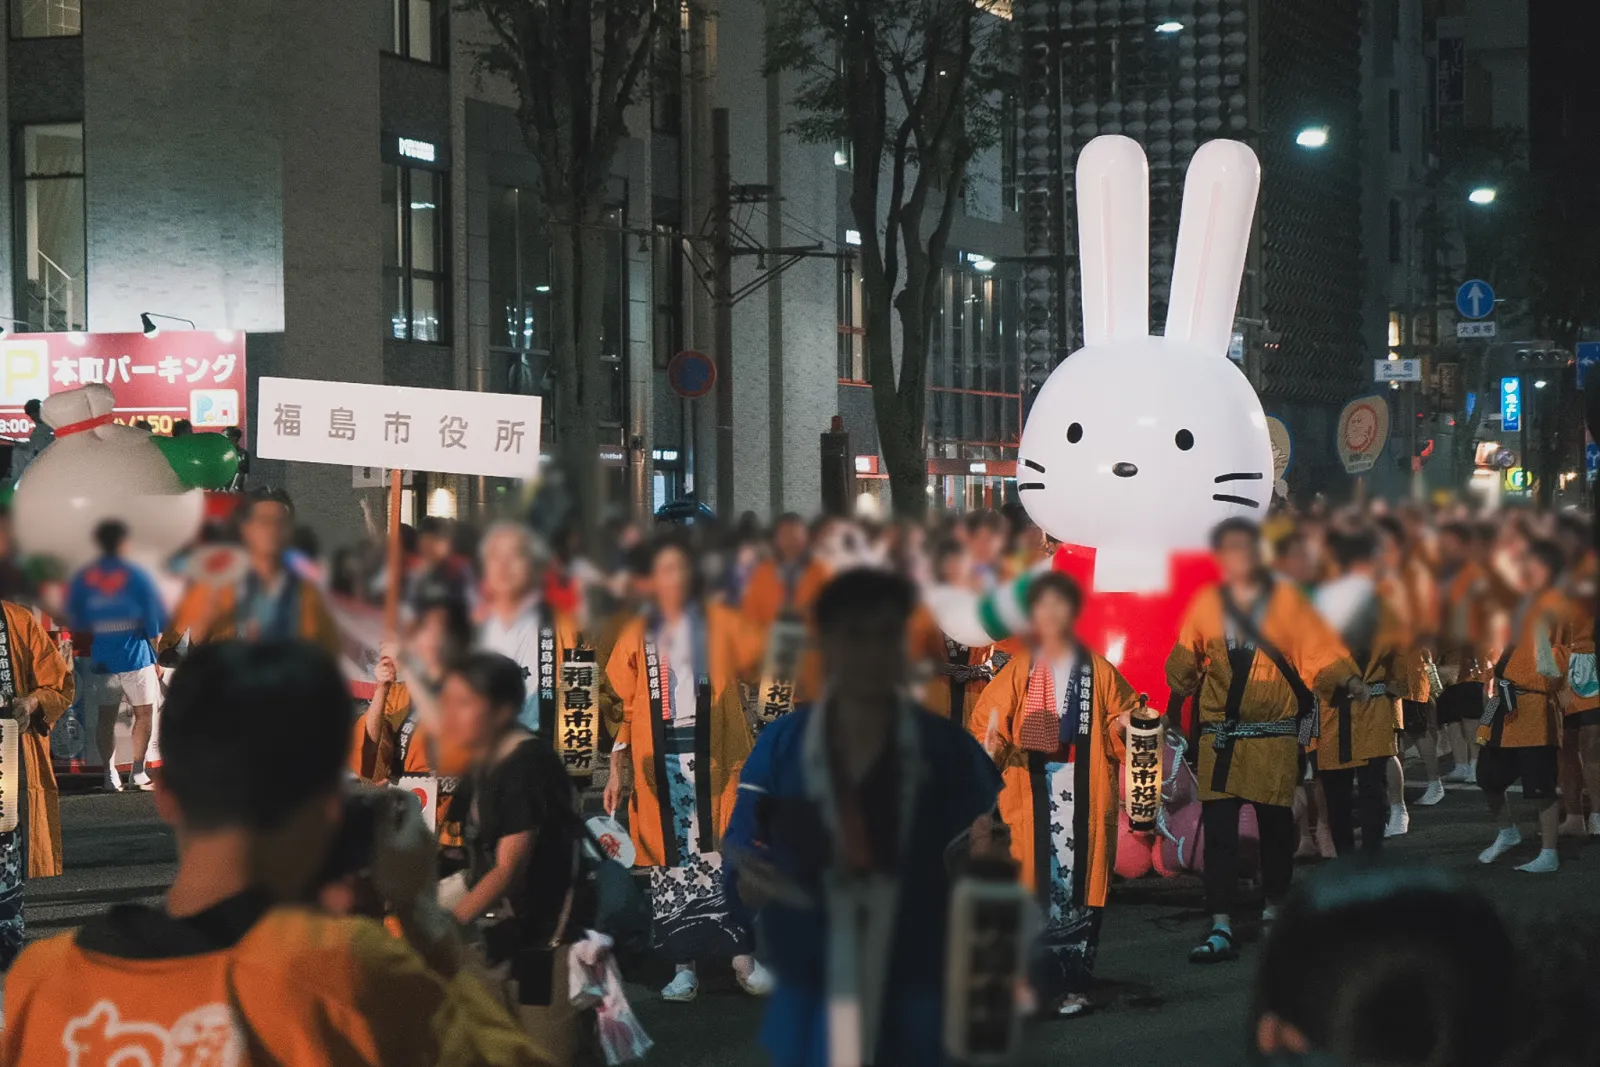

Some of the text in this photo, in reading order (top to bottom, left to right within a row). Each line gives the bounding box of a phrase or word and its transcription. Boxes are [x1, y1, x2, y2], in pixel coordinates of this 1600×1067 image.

[5, 349, 39, 398] P
[52, 354, 237, 386] 本町パーキング
[273, 403, 525, 455] 福島市役所
[541, 639, 553, 700] 福島市役所
[645, 642, 660, 700] 福島市役所
[563, 666, 594, 769] 福島市役所
[1078, 676, 1092, 735] 福島市役所
[1131, 733, 1159, 818] 福島市役所
